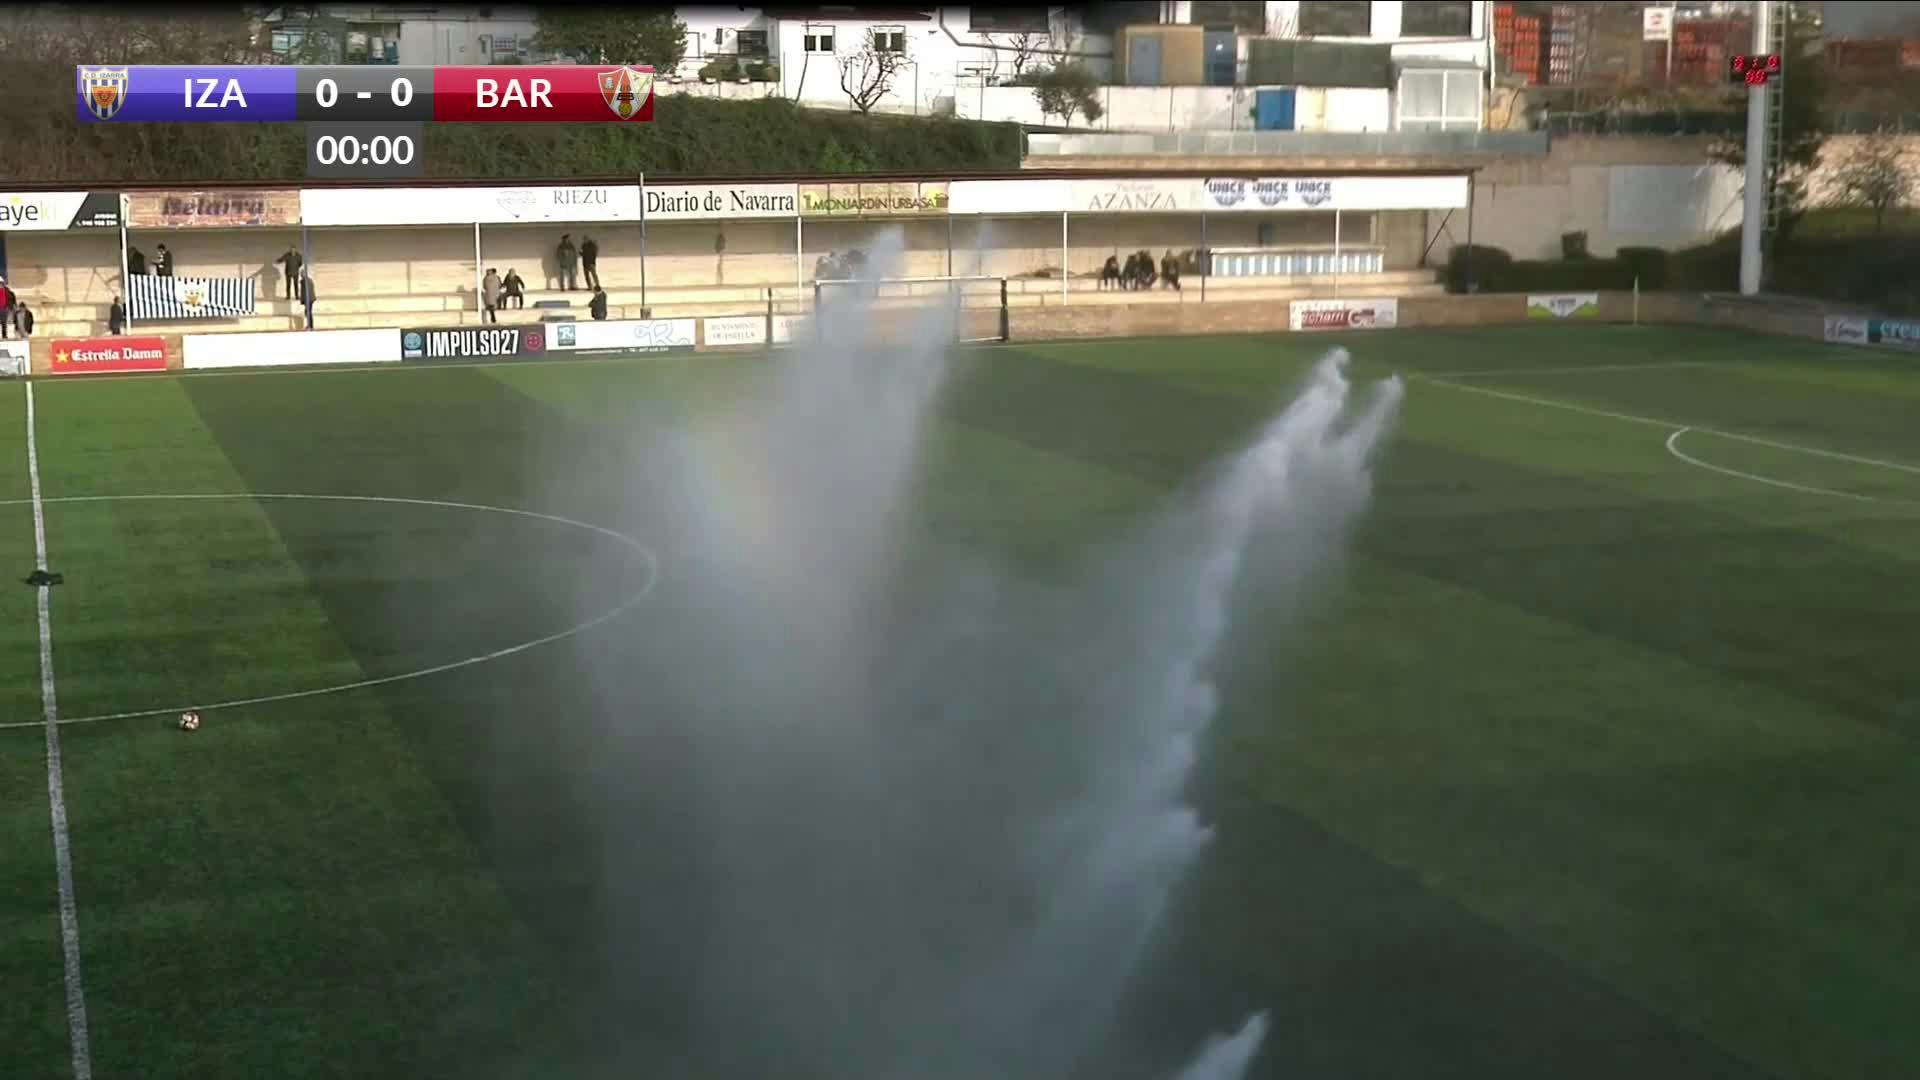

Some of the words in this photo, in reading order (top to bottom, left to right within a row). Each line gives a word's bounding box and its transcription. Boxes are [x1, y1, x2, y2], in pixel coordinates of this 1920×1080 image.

[553, 189, 607, 205] RIEZU
[646, 191, 699, 213] Diario
[703, 190, 723, 212] de
[729, 190, 795, 212] Navarra
[1088, 192, 1177, 210] AZANZA
[426, 329, 519, 358] IMPULSO27
[71, 348, 120, 362] Estrella
[122, 347, 163, 360] Damm
